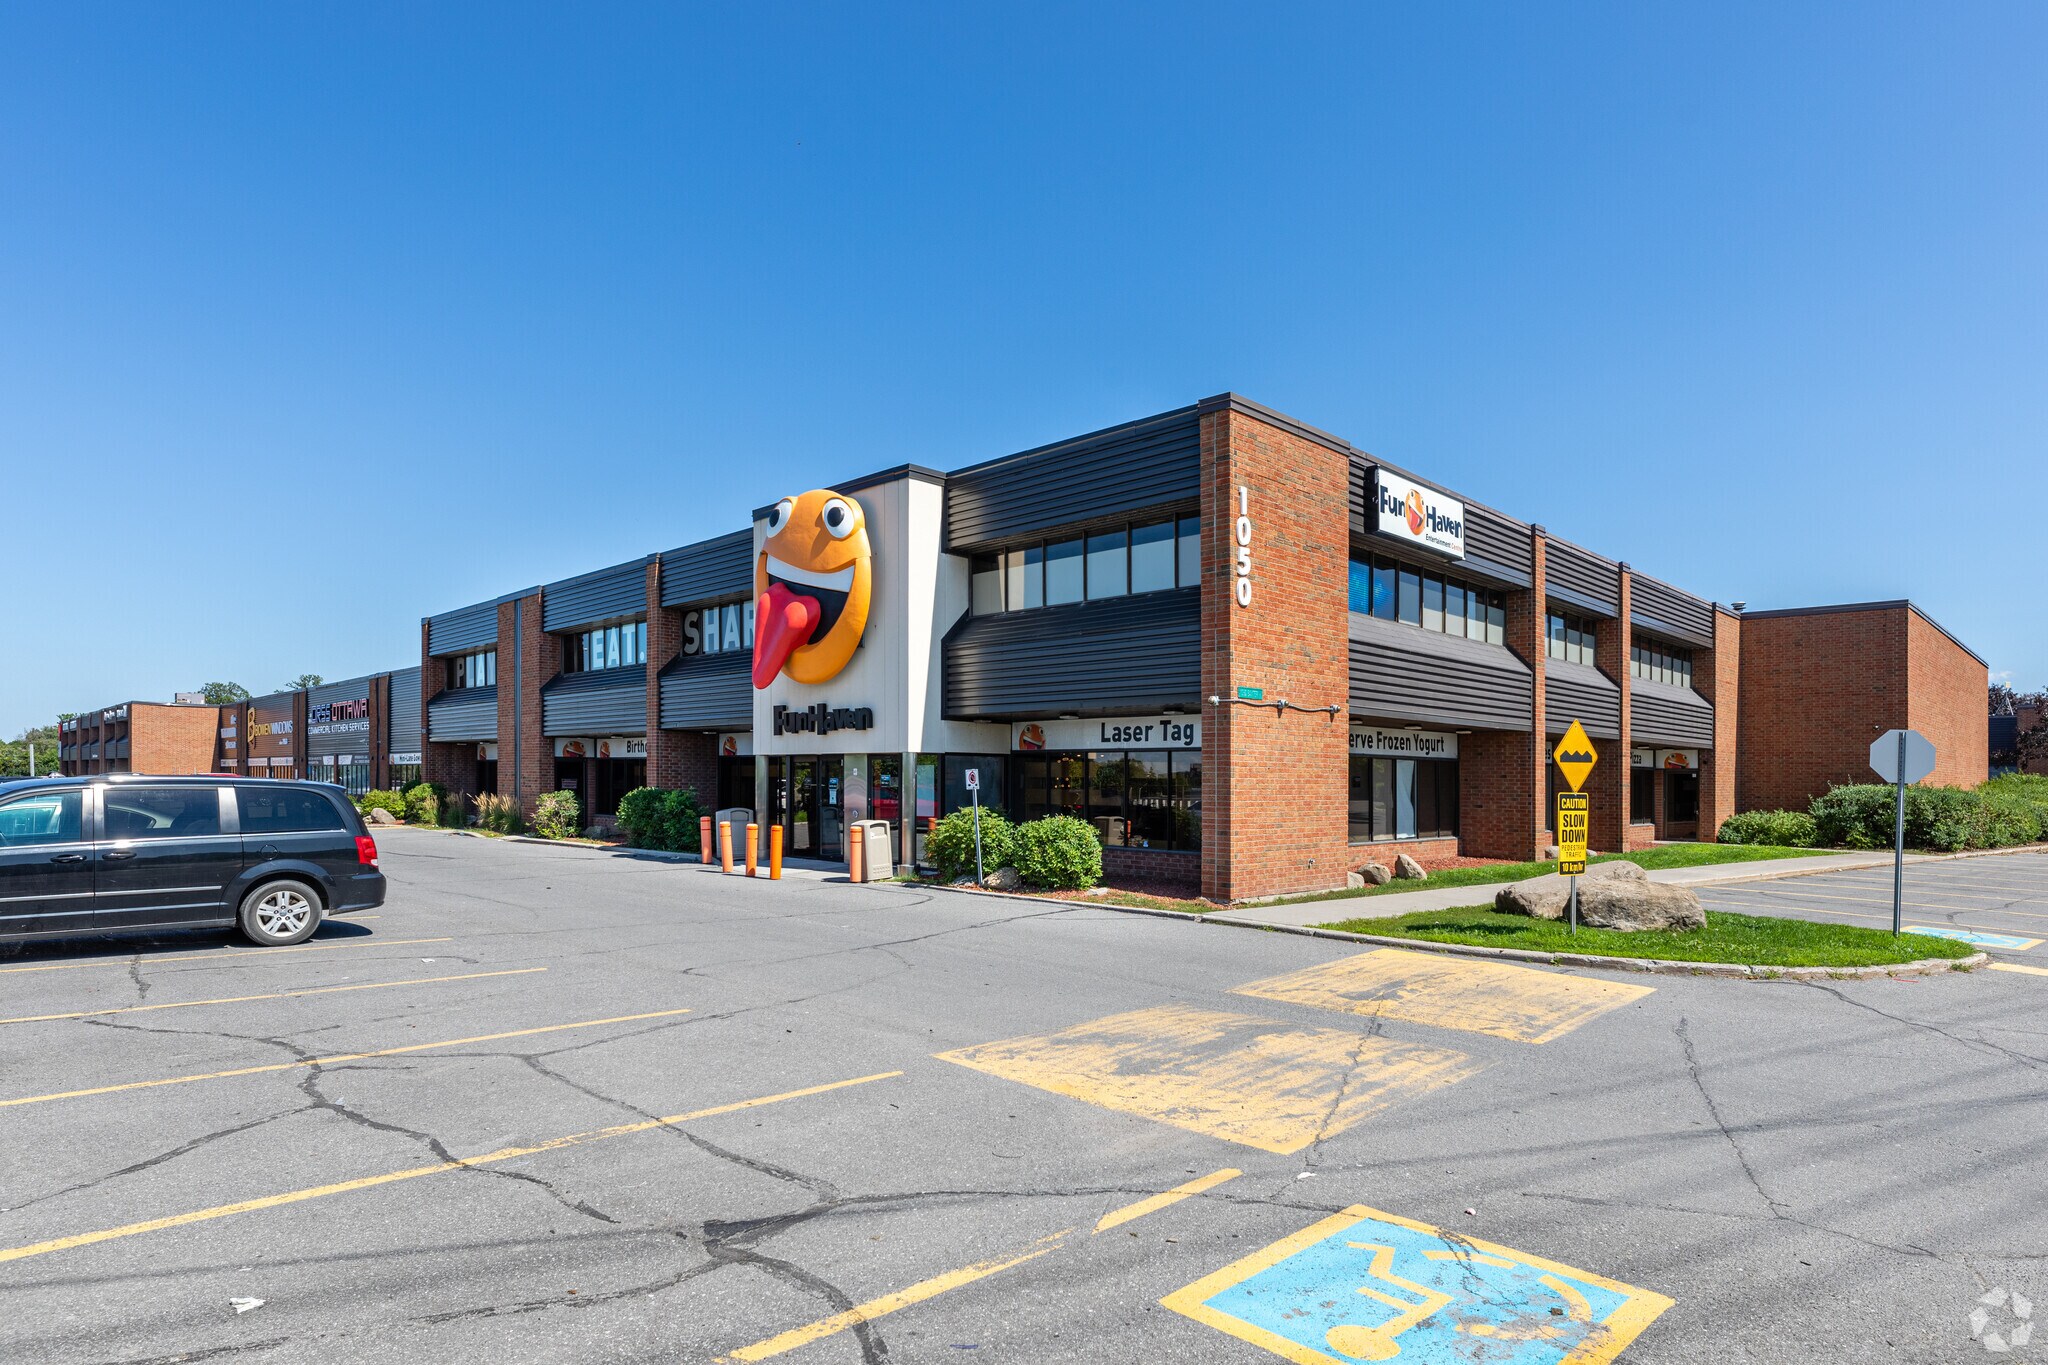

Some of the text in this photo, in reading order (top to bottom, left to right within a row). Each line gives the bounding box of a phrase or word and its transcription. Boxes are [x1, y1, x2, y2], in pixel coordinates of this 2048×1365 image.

[1380, 485, 1463, 539] Fun Haven
[1236, 486, 1252, 607] 1050
[332, 698, 368, 721] OTTAWA
[773, 703, 874, 736] FunHaven
[348, 721, 369, 731] SERVICES
[1101, 719, 1194, 746] Laser Tag
[1377, 731, 1411, 751] Frozen
[1413, 734, 1445, 755] Yogurt
[1561, 798, 1586, 809] CAUTION
[1563, 814, 1585, 828] SLOW
[1562, 829, 1585, 843] DOWN
[1562, 862, 1569, 872] 10
